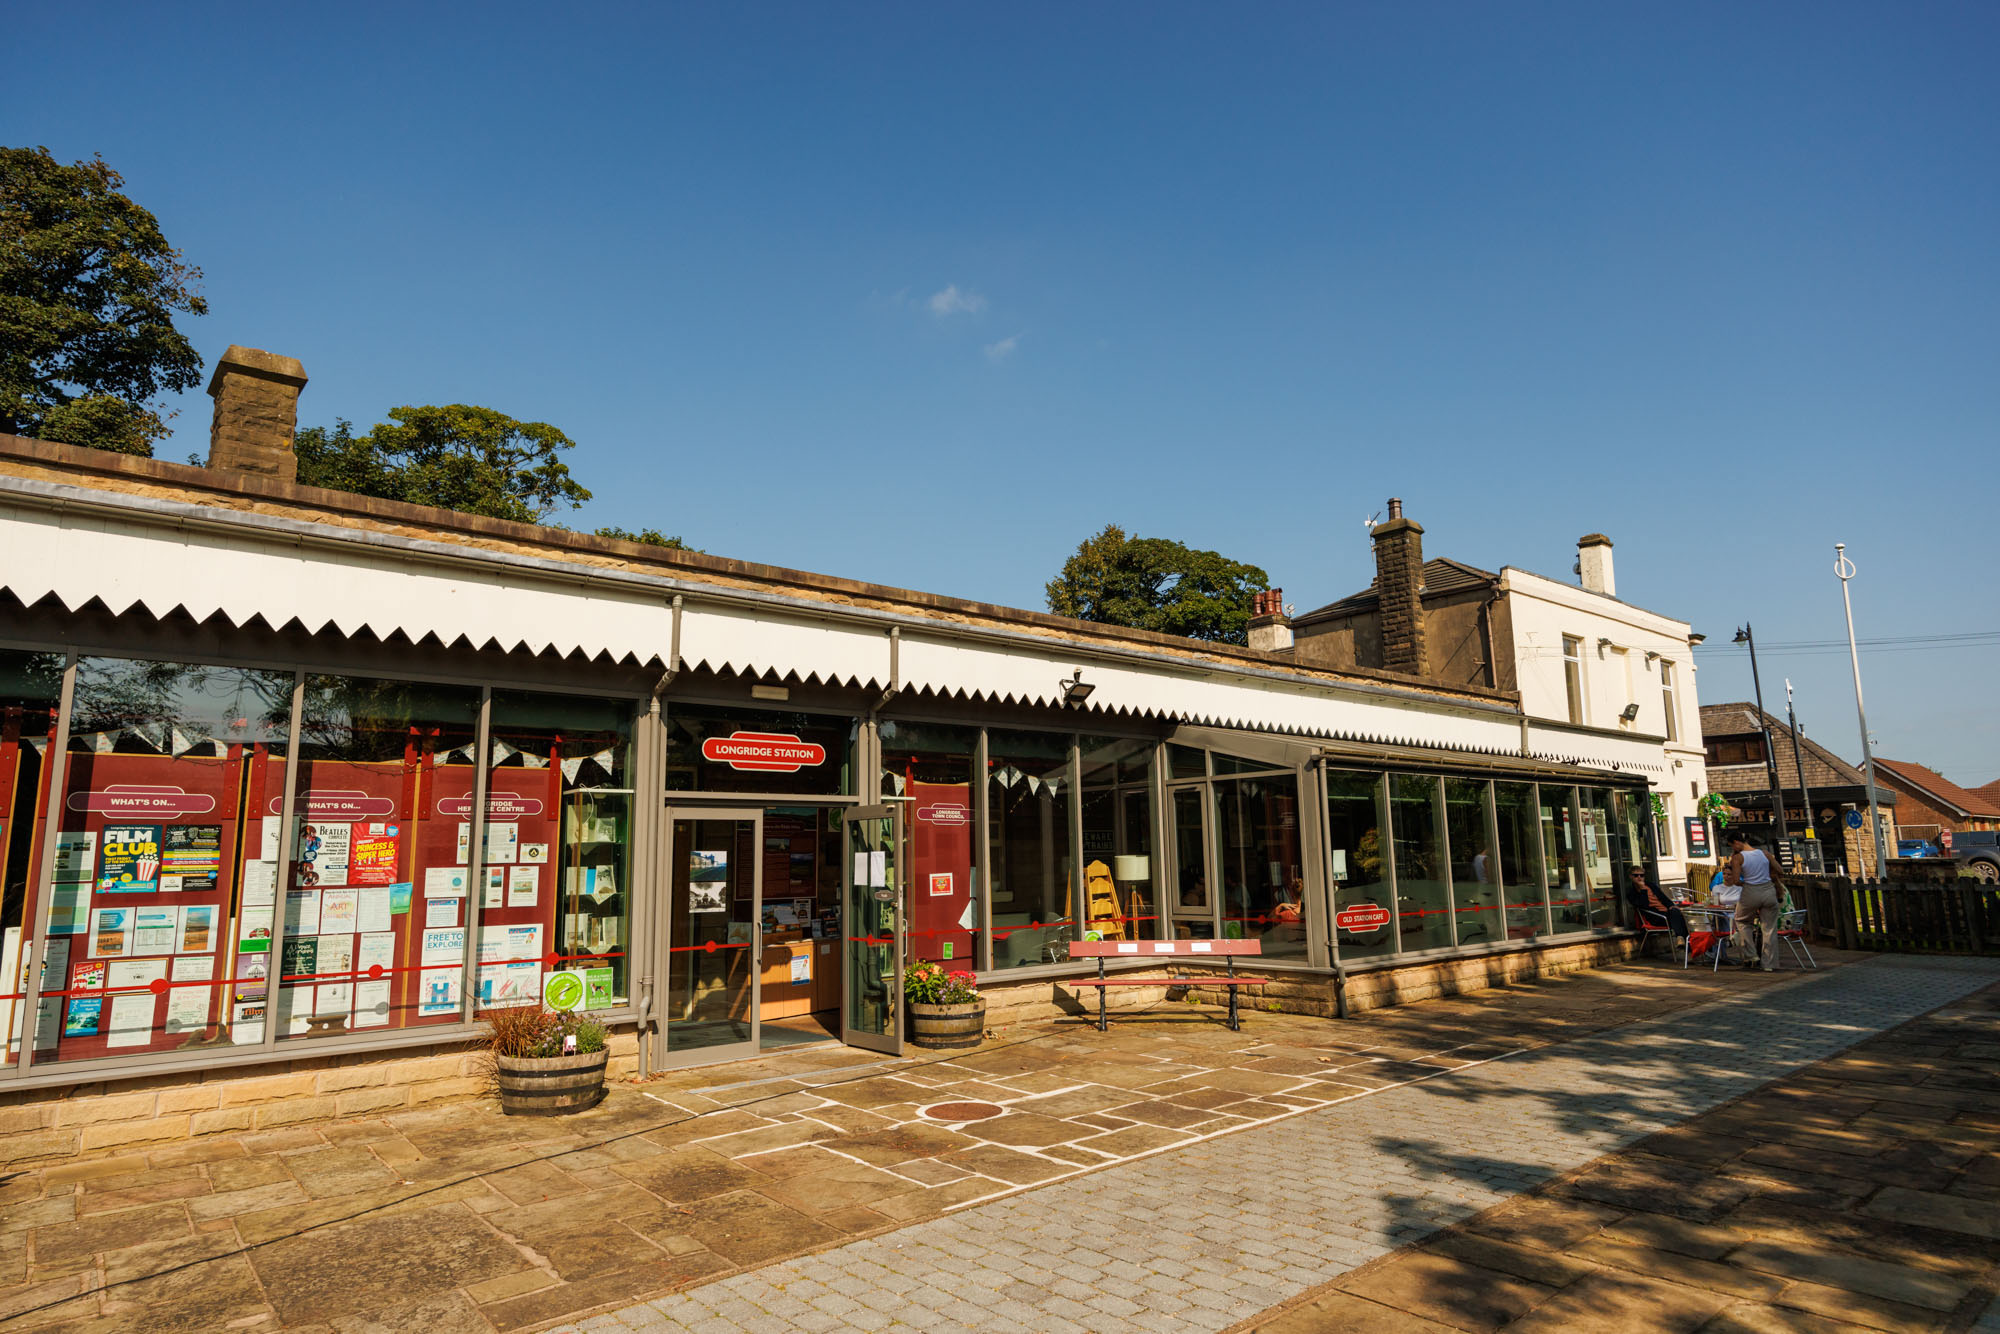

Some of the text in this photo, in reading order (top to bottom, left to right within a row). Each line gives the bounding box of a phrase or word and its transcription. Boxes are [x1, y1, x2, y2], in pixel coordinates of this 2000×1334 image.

[716, 745, 814, 759] LONGRIDGE STATION
[110, 798, 150, 806] WHAT'S
[320, 826, 348, 835] BEATLES
[104, 830, 152, 844] FILM
[104, 842, 157, 856] CLUB
[356, 843, 387, 852] PRINCESS
[356, 851, 376, 860] SUPER
[378, 849, 396, 857] HERO
[330, 902, 348, 910] ART
[1373, 912, 1383, 920] CAFÉ
[245, 1008, 264, 1016] film
